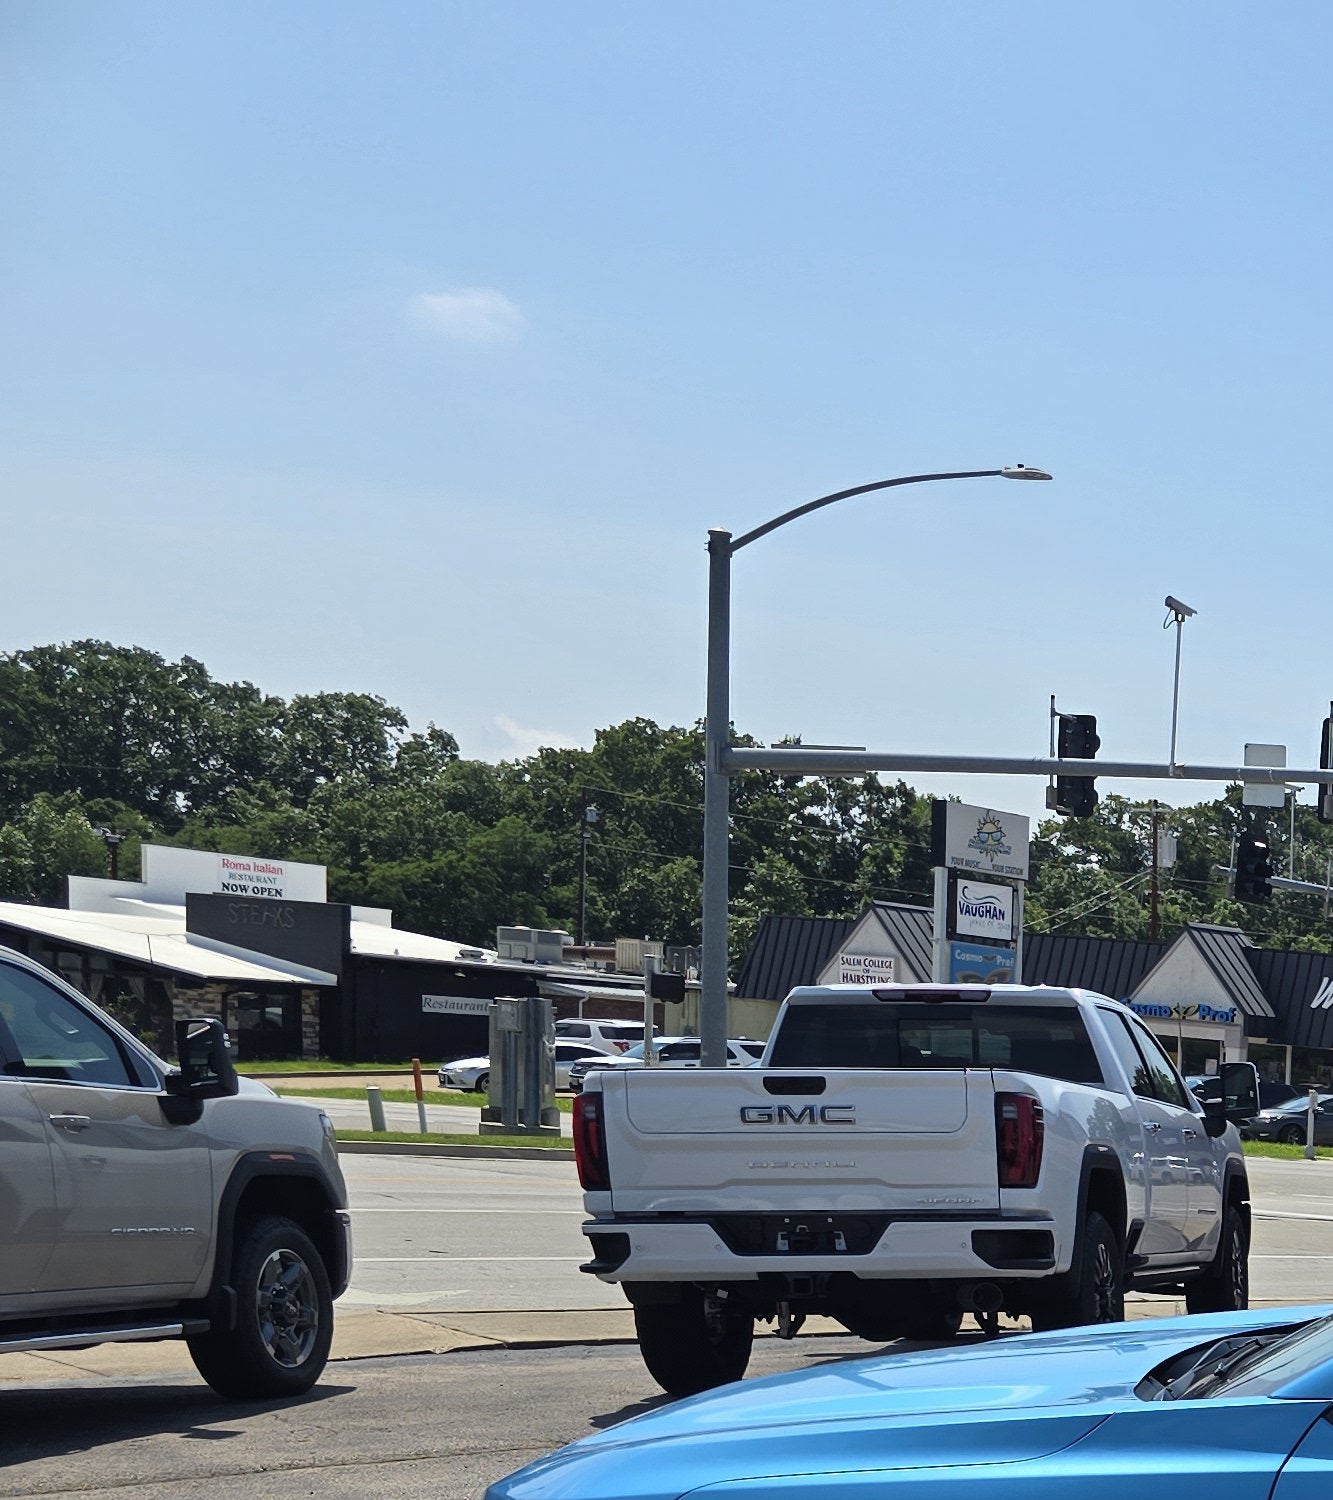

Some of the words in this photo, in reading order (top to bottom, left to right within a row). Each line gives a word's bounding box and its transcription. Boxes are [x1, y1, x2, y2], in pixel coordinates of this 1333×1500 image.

[222, 858, 251, 871] Roma
[253, 862, 283, 875] Italian
[221, 882, 249, 894] NOW
[252, 886, 283, 898] OPEN
[228, 902, 296, 929] STEAKS
[958, 901, 1006, 921] VAUGHAN
[841, 956, 862, 967] SALEM
[863, 957, 893, 969] COLLEGE
[955, 949, 983, 962] Cosmo
[996, 954, 1015, 967] Prof
[423, 997, 488, 1012] Restaurant
[1199, 1003, 1237, 1023] Prof
[739, 1104, 856, 1126] GMC
